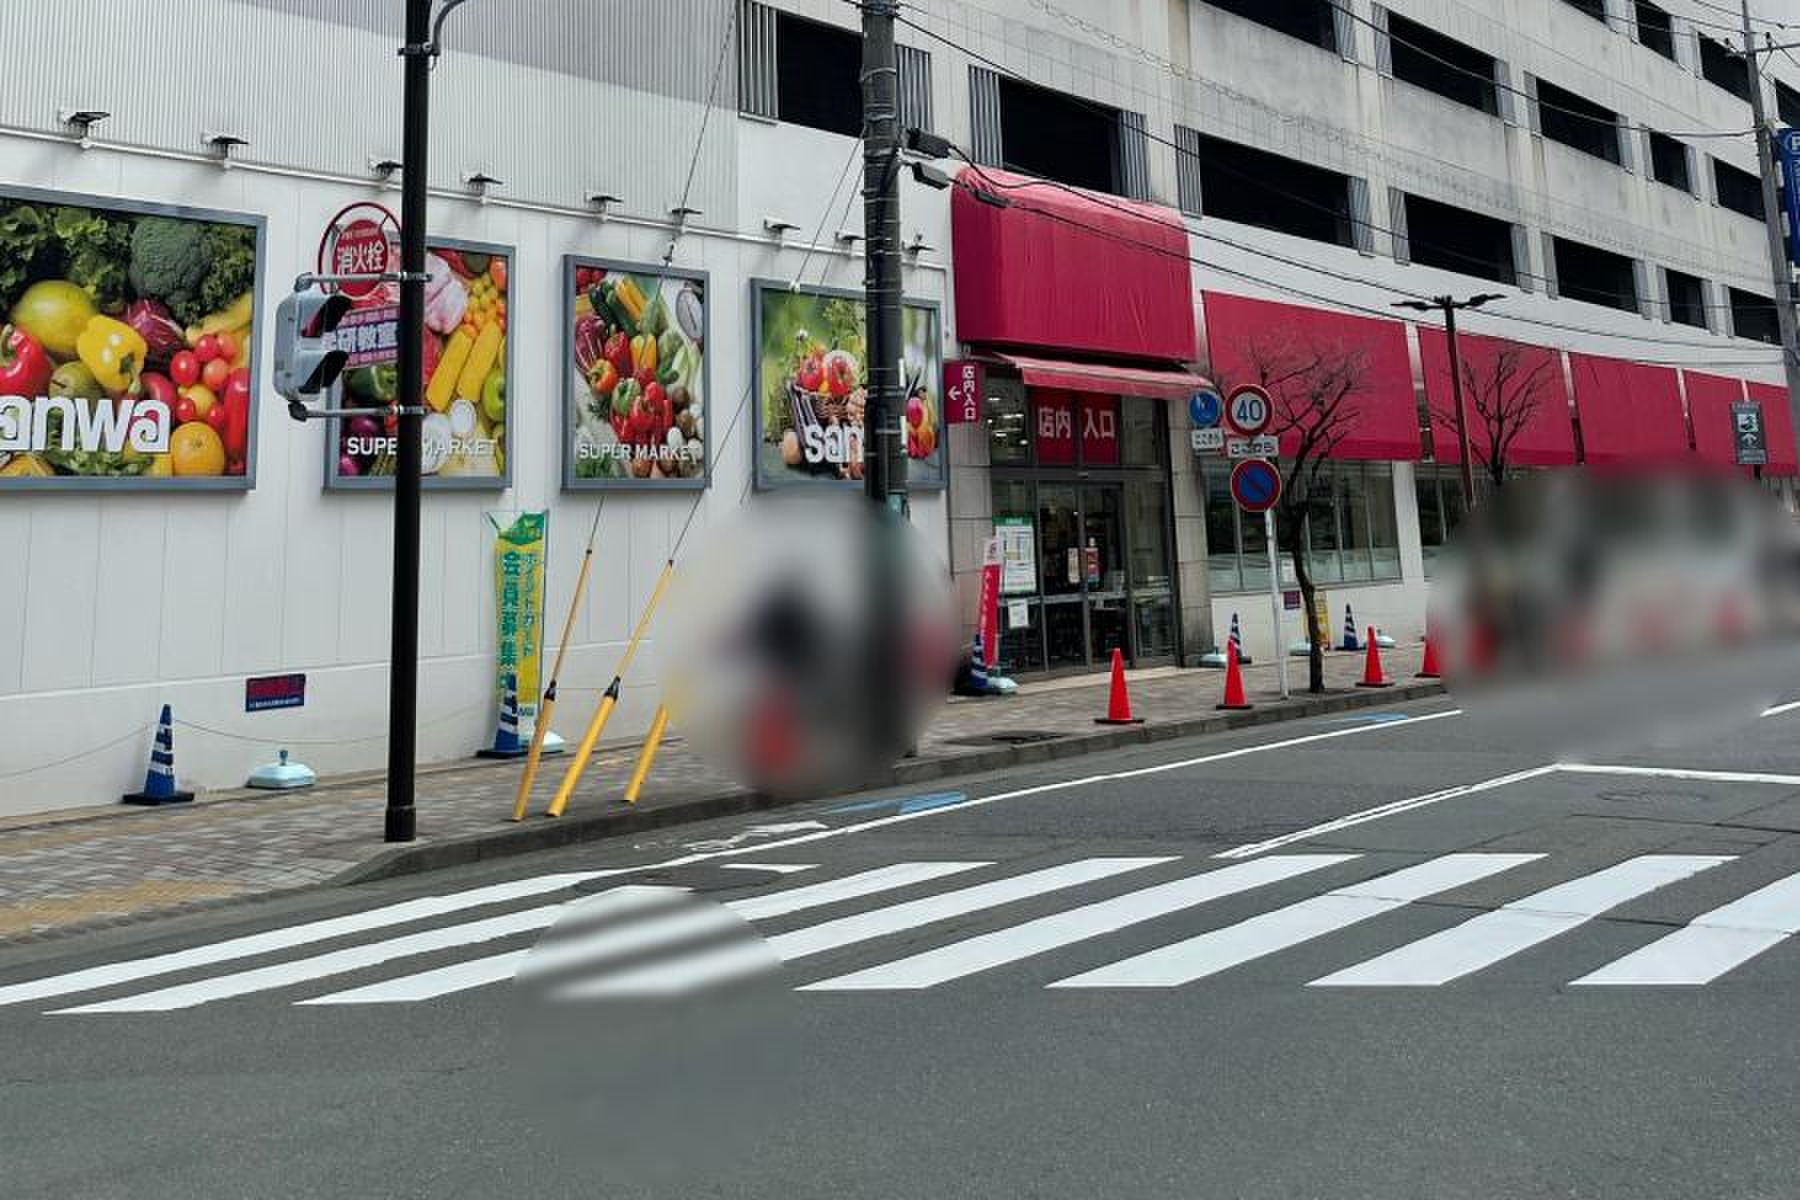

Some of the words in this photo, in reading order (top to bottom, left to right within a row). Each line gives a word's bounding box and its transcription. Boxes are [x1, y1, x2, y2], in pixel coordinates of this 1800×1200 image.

[336, 240, 384, 276] 消火栓
[962, 365, 977, 420] 店内入口
[0, 395, 171, 453] anwa
[1038, 405, 1072, 439] 店内
[1083, 407, 1116, 439] 入口
[1236, 399, 1263, 422] 40
[347, 436, 398, 456] SUPE
[579, 442, 632, 460] SUPER
[635, 442, 699, 465] MARKET
[804, 423, 865, 463] san
